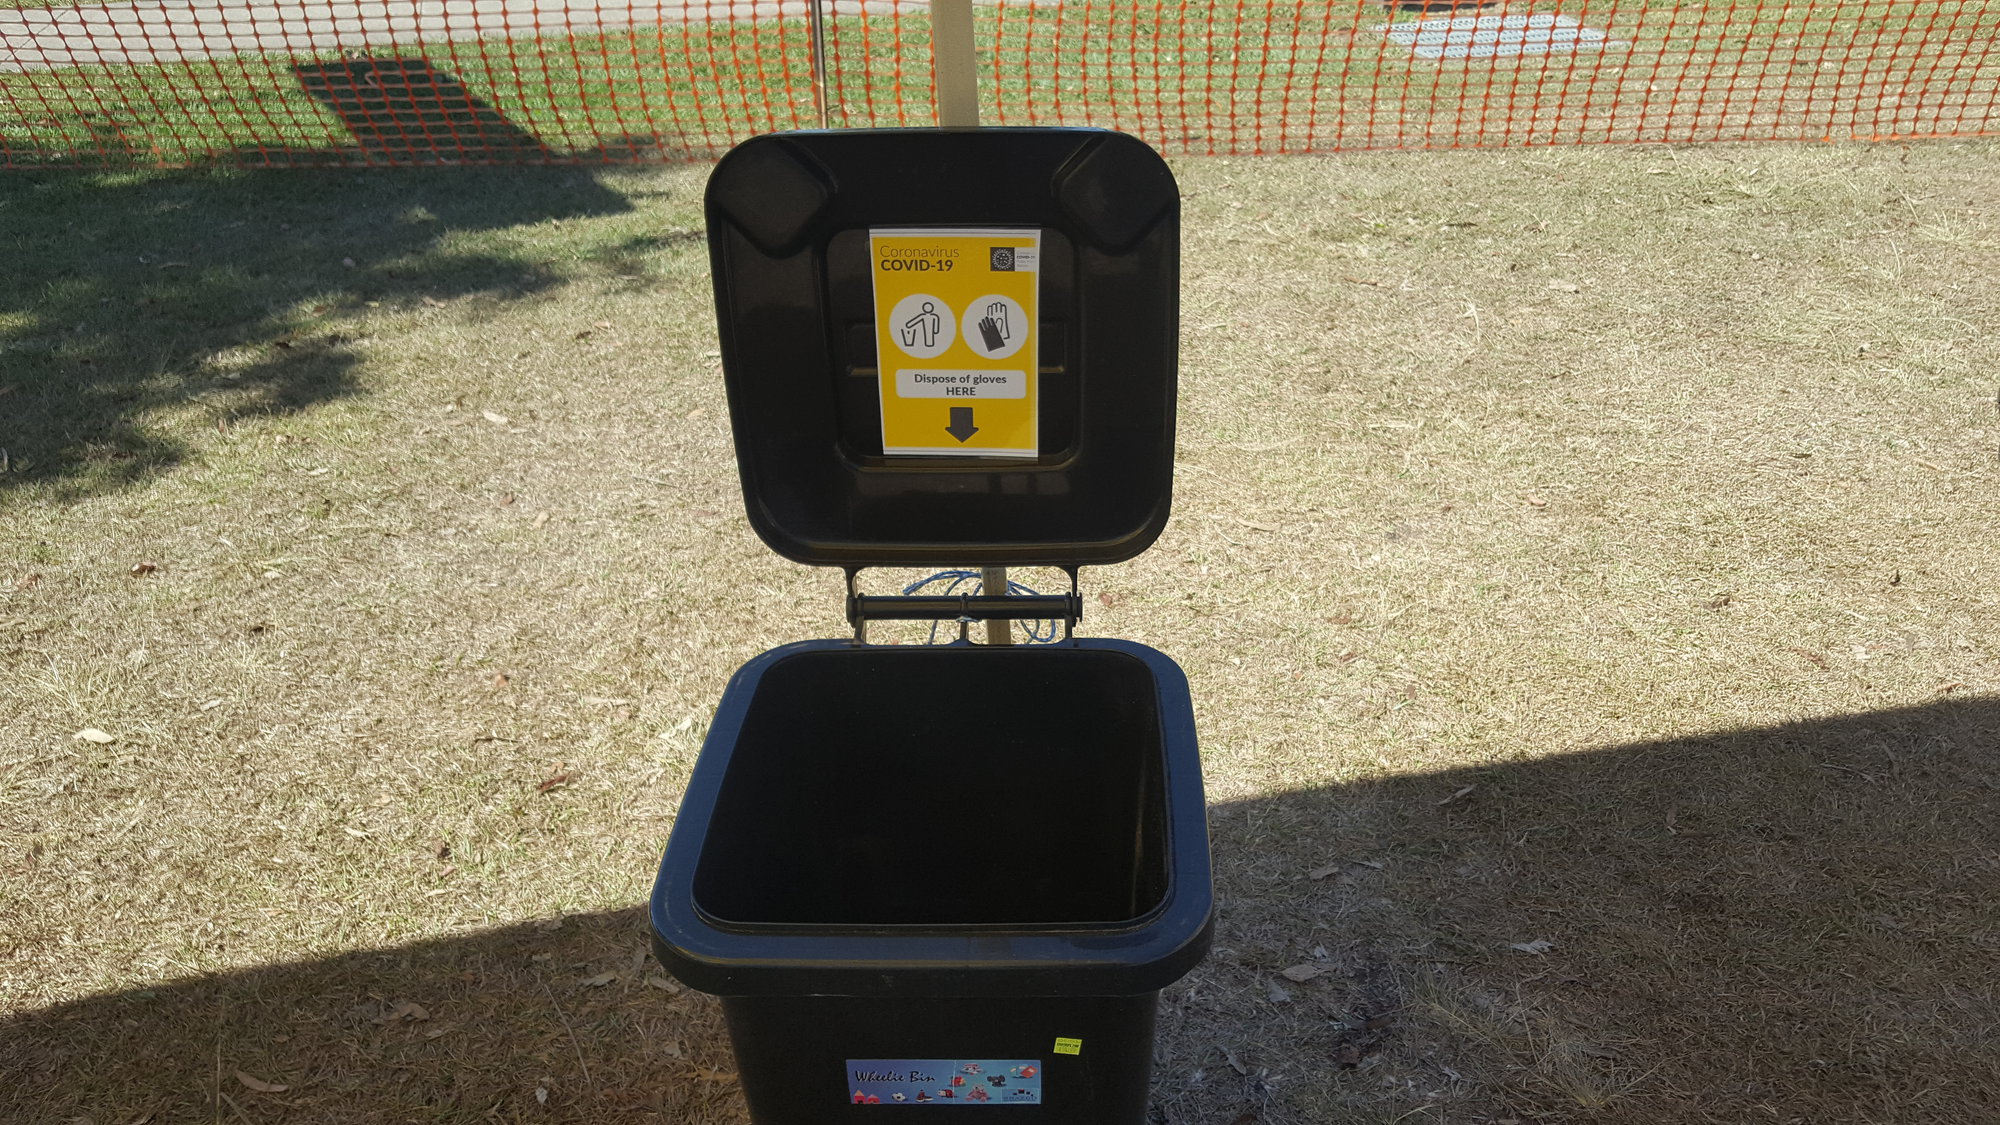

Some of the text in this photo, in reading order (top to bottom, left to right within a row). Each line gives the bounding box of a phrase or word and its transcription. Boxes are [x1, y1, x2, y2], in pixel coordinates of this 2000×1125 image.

[880, 245, 959, 258] Coronavirus
[881, 260, 953, 272] COVID-19
[914, 374, 1007, 385] Dispose of gloves
[946, 387, 976, 396] HERE
[855, 1070, 935, 1083] Wheelie Bin
